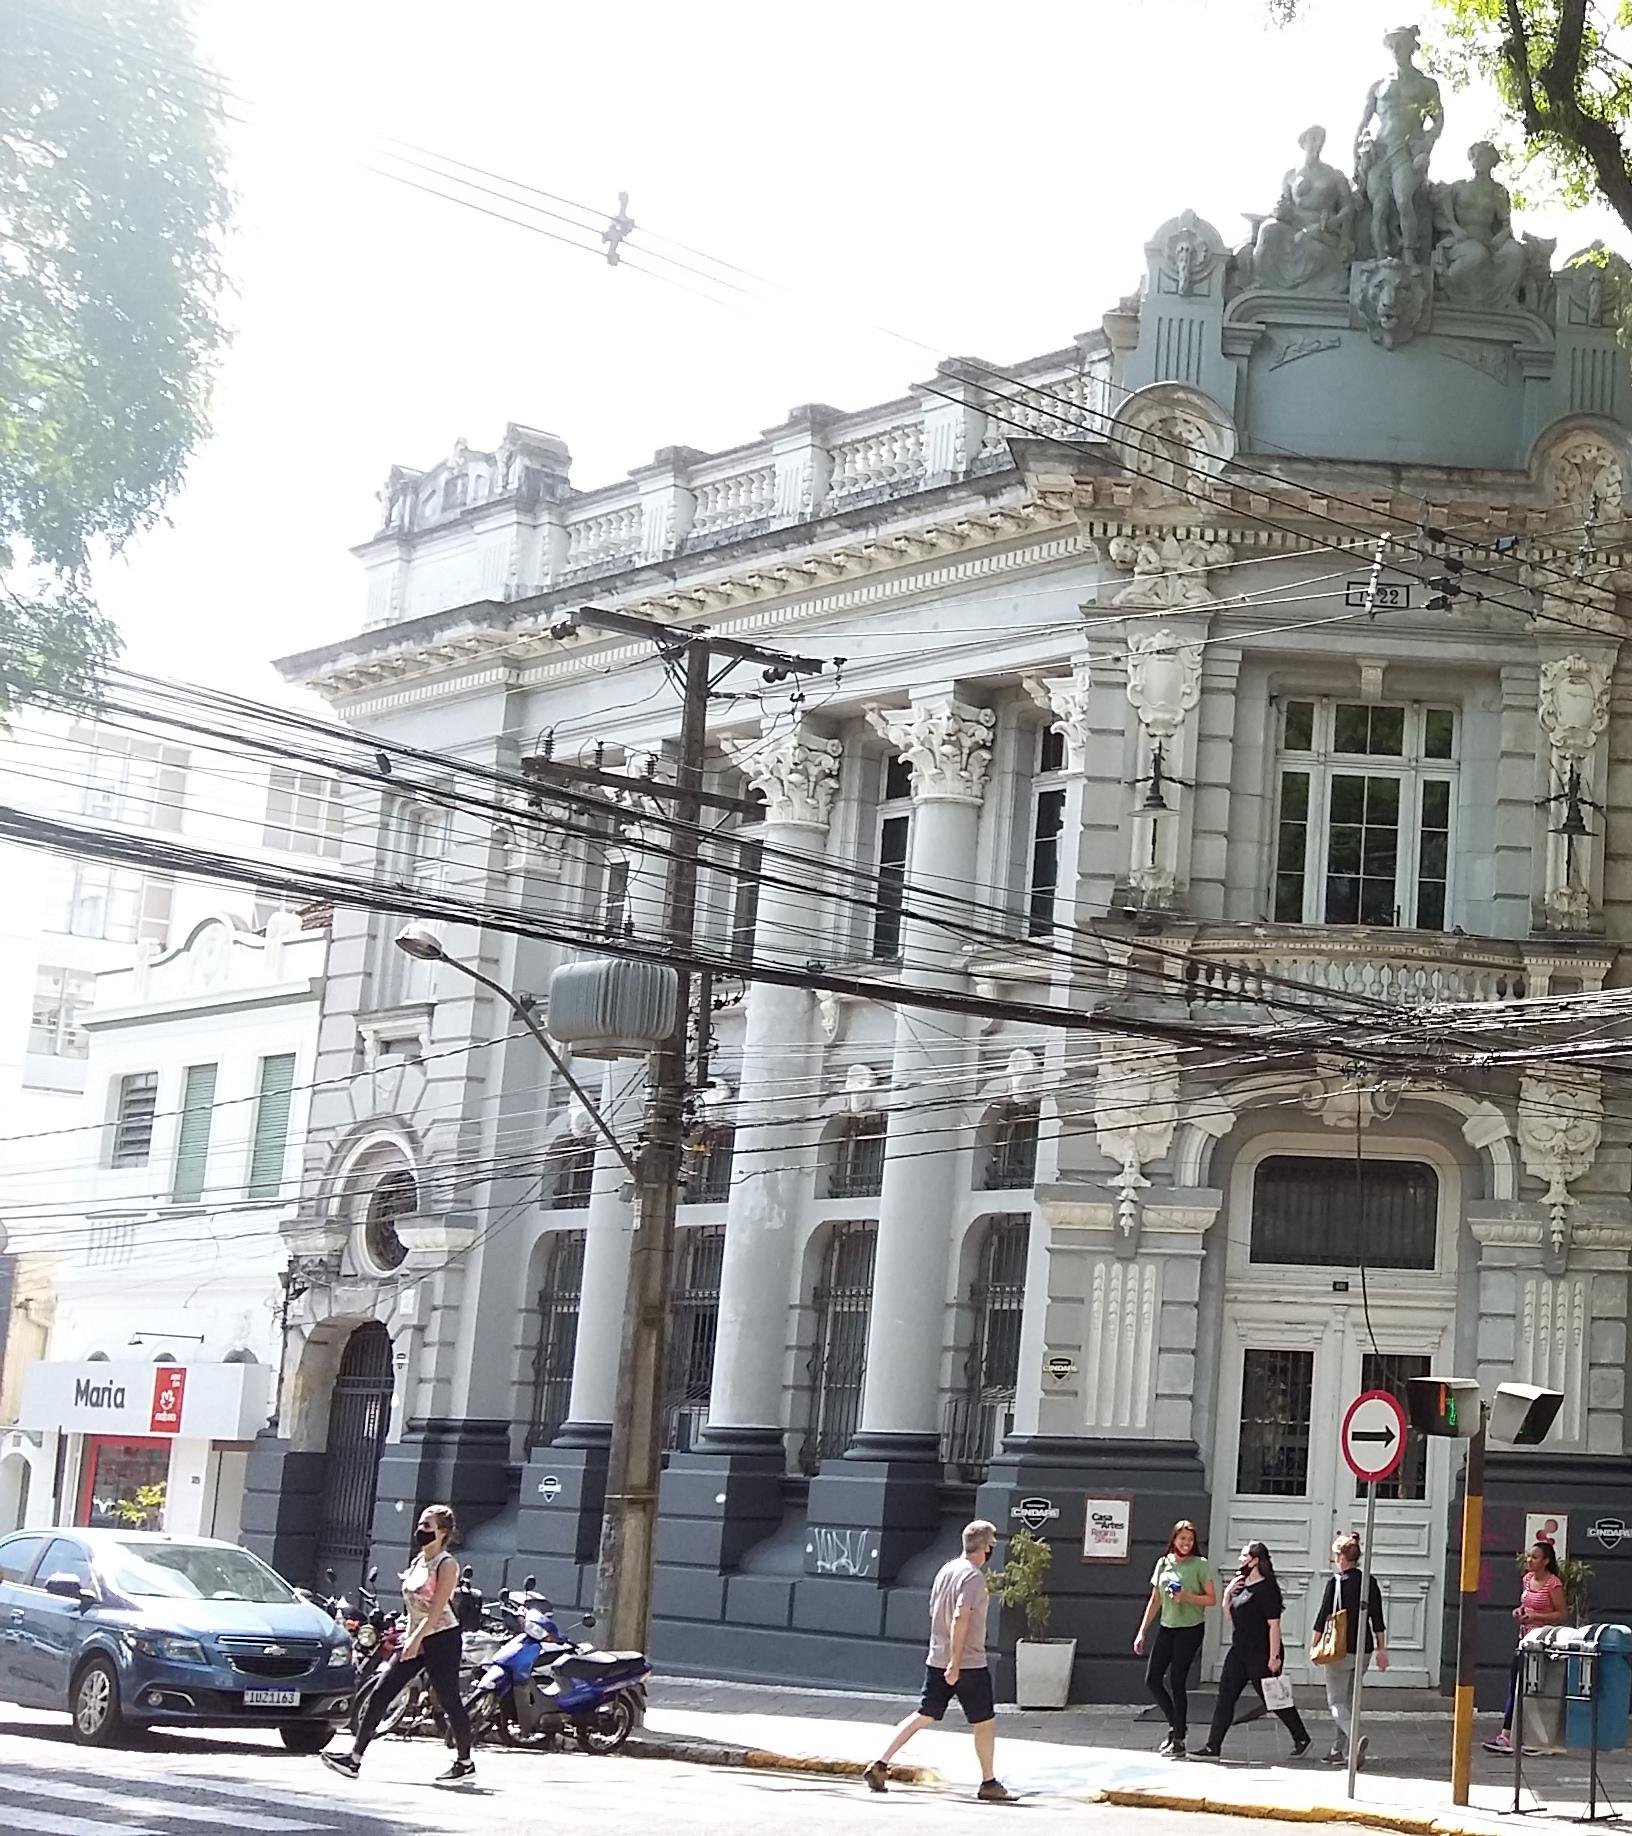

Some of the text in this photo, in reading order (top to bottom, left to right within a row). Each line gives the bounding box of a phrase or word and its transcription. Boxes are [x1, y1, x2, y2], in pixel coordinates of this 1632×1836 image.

[1360, 588, 1399, 604] 122
[74, 1378, 126, 1409] Maria
[1091, 1512, 1113, 1521] Casa
[1101, 1521, 1124, 1530] Artes
